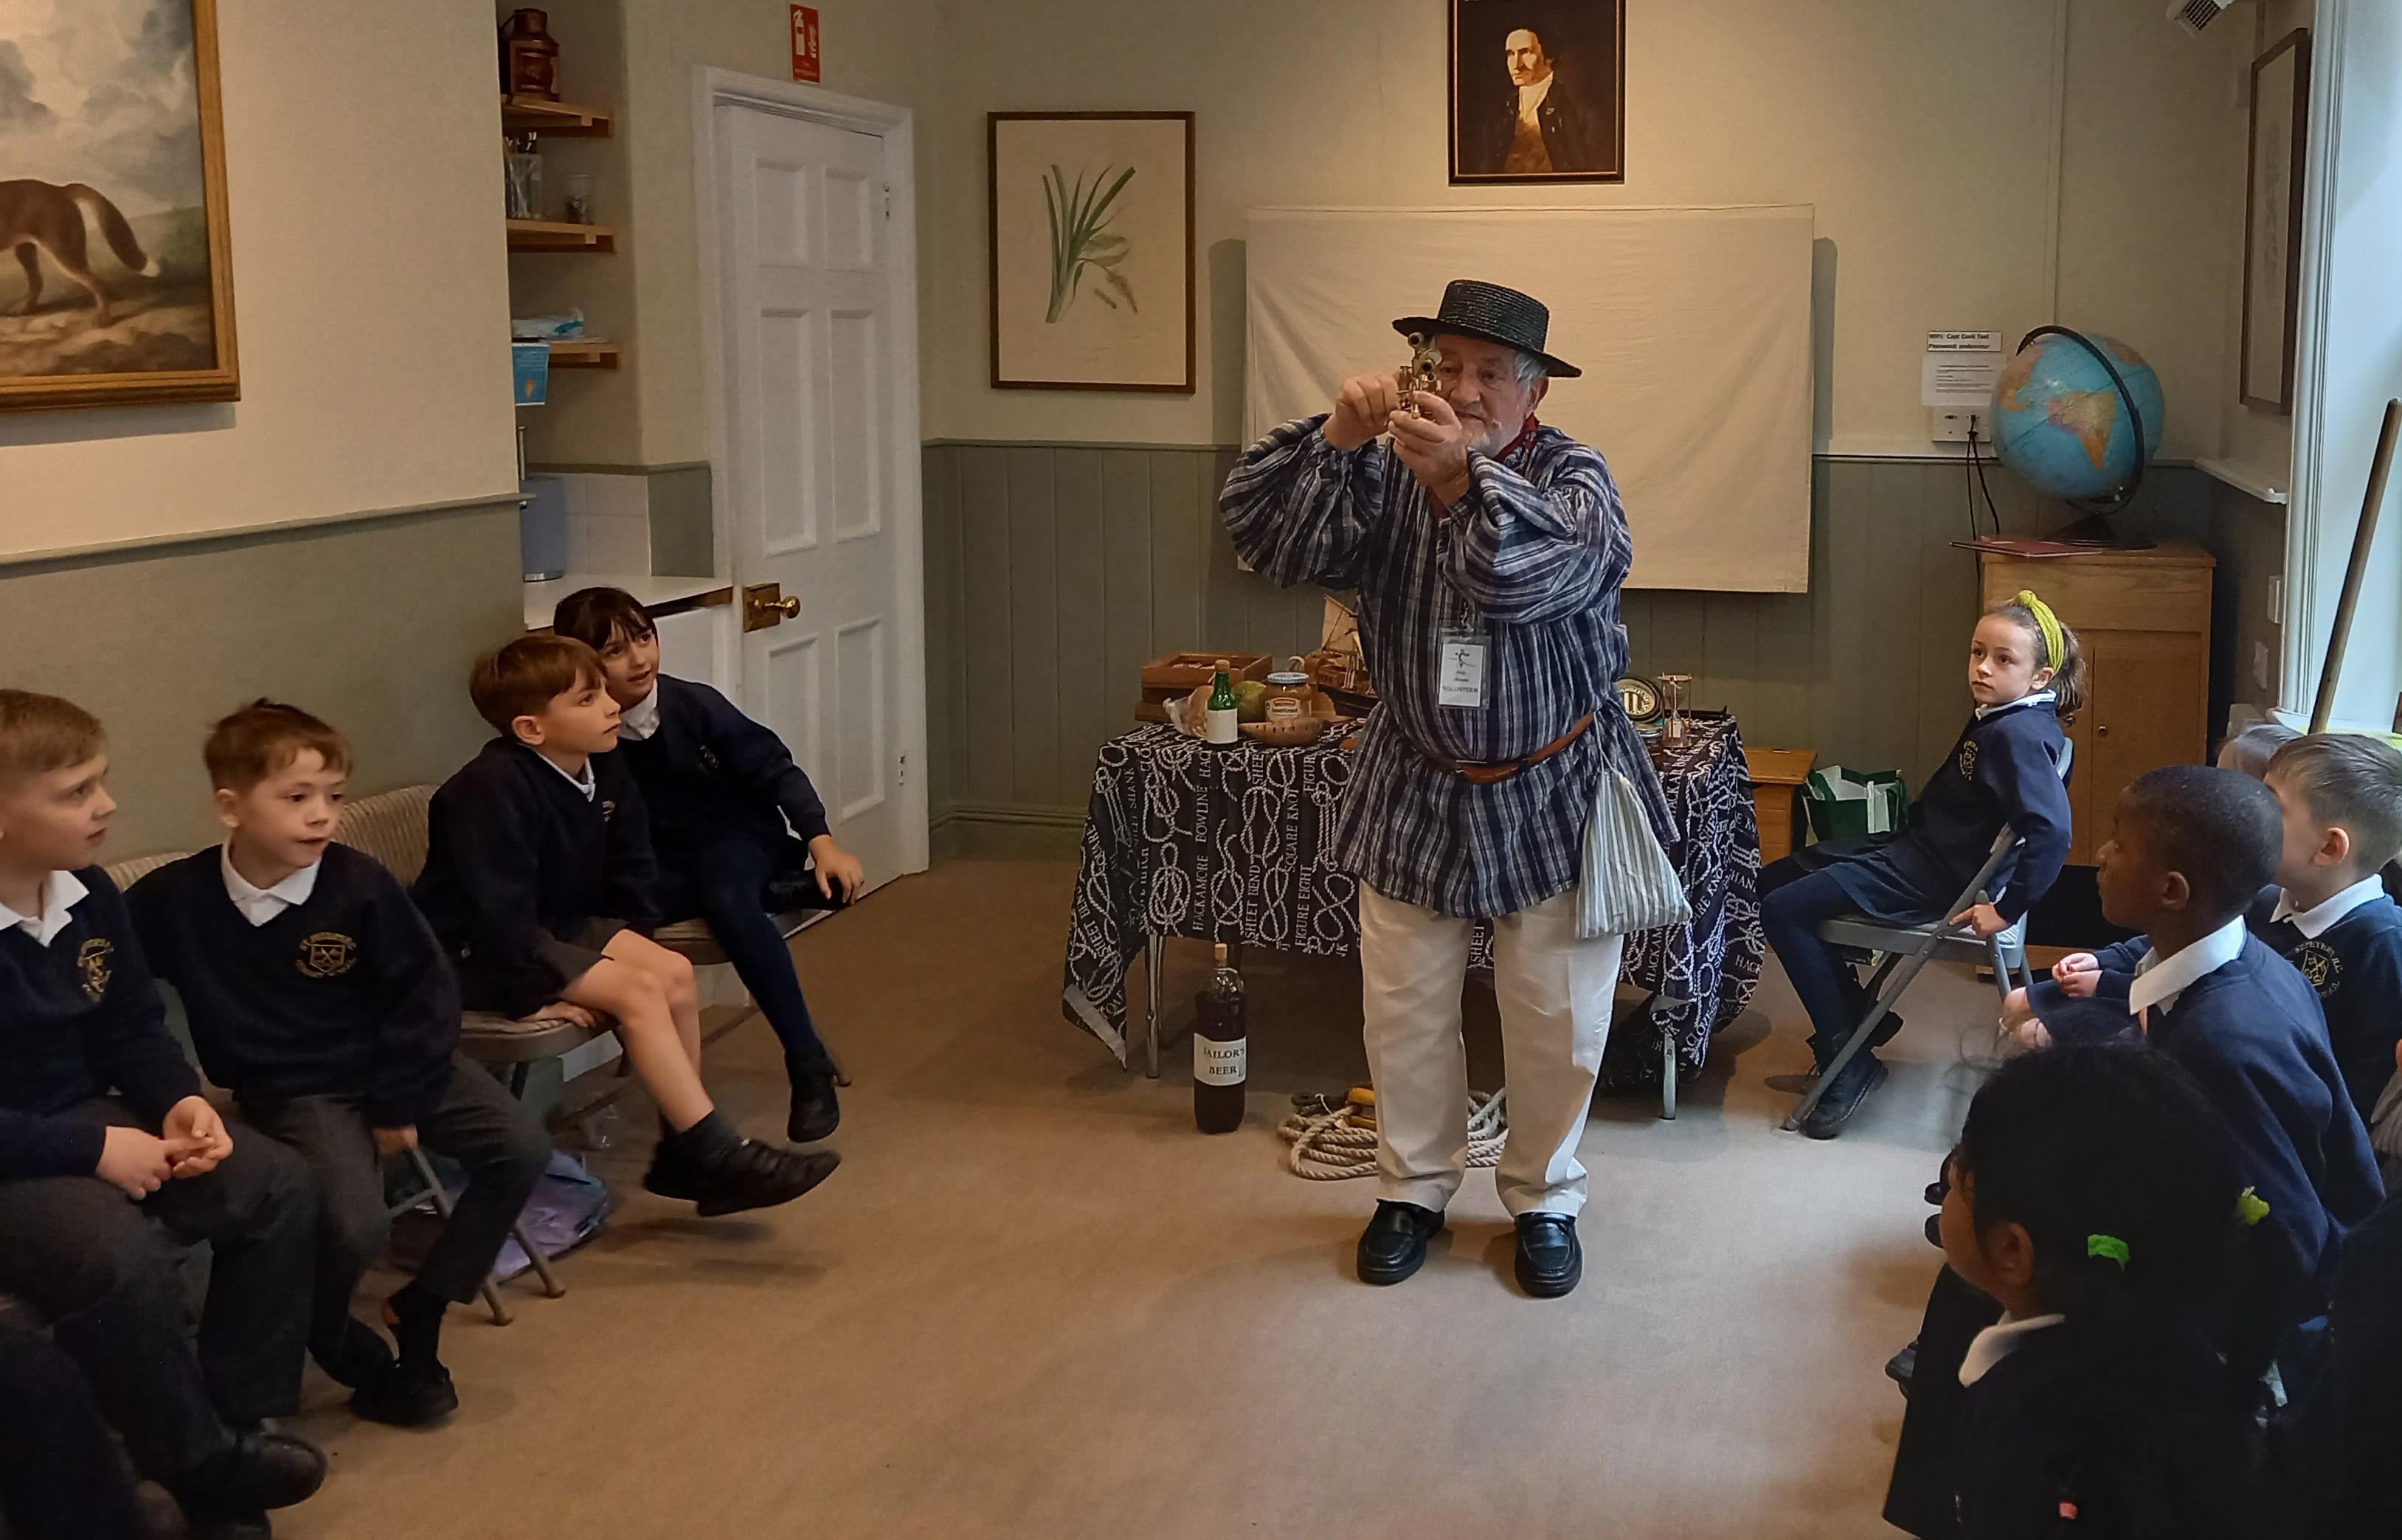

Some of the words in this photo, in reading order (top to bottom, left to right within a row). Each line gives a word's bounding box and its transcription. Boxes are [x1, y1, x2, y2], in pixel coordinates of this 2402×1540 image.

[1194, 785, 1209, 843] BOWLINE
[1286, 788, 1299, 820] KNOT
[1284, 825, 1299, 873] SQUARE
[1192, 855, 1209, 932] HACKAMORE
[1247, 864, 1261, 897] BEND
[1298, 864, 1313, 897] EIGHT
[1245, 901, 1260, 940] SHEET
[1295, 898, 1309, 947] FIGURE
[1209, 1065, 1238, 1075] BEER
